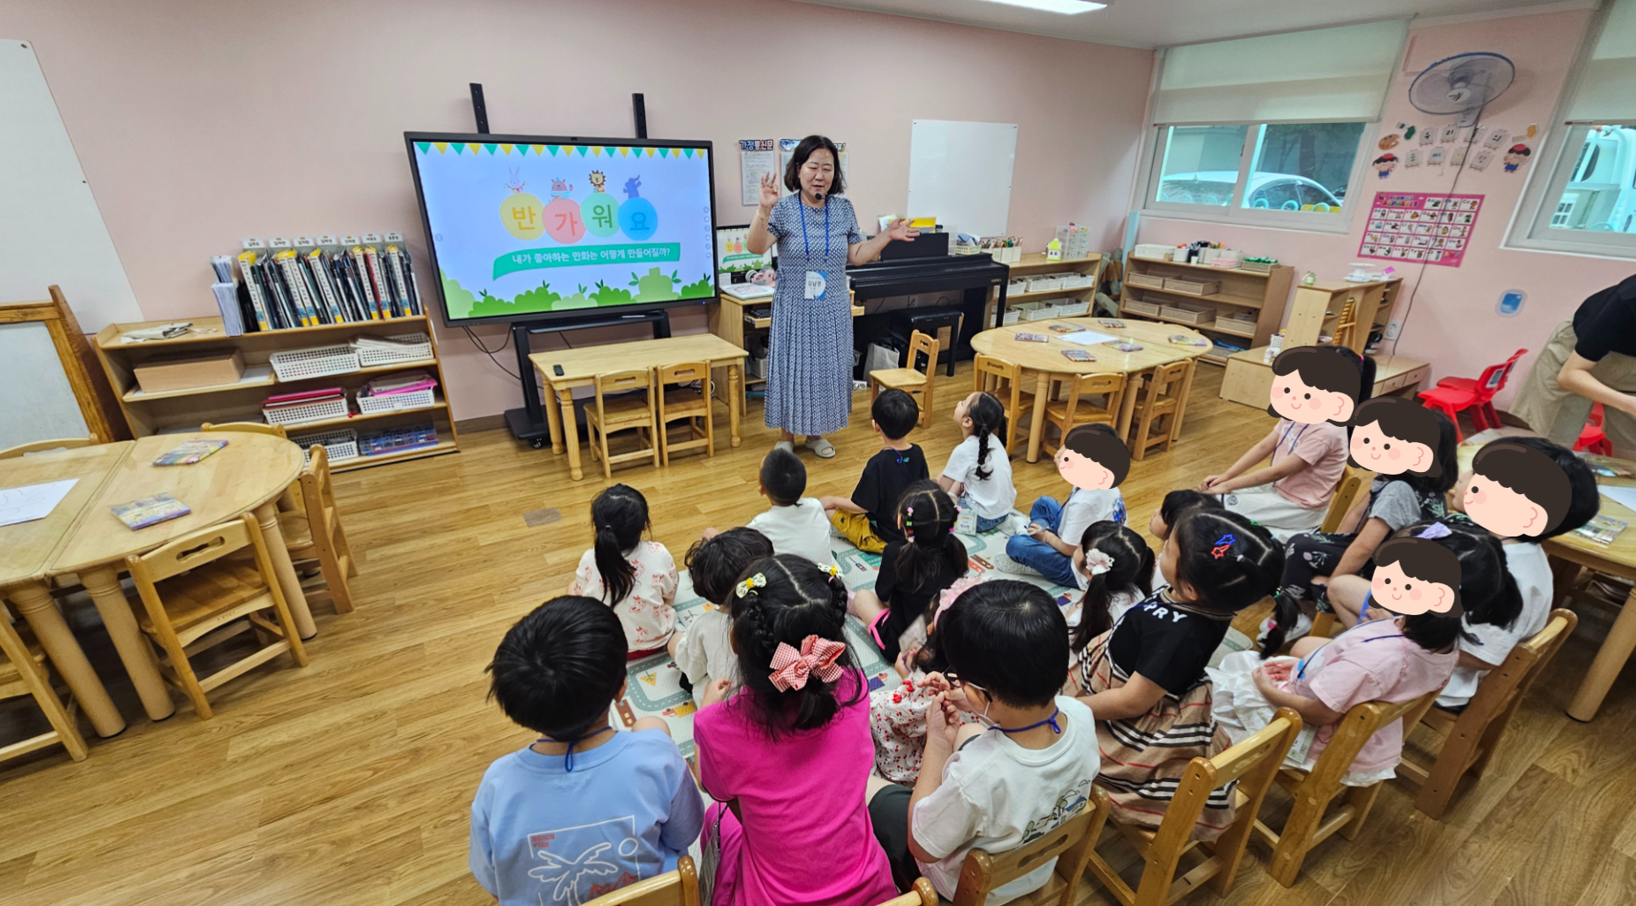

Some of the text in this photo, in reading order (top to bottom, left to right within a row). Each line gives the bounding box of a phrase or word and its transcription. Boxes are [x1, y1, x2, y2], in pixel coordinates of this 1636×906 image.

[738, 139, 774, 152] 가정통신문
[512, 204, 650, 236] 반가워요
[512, 247, 671, 265] 내가 좋아하는 만화는 어떻게 만들어질까?
